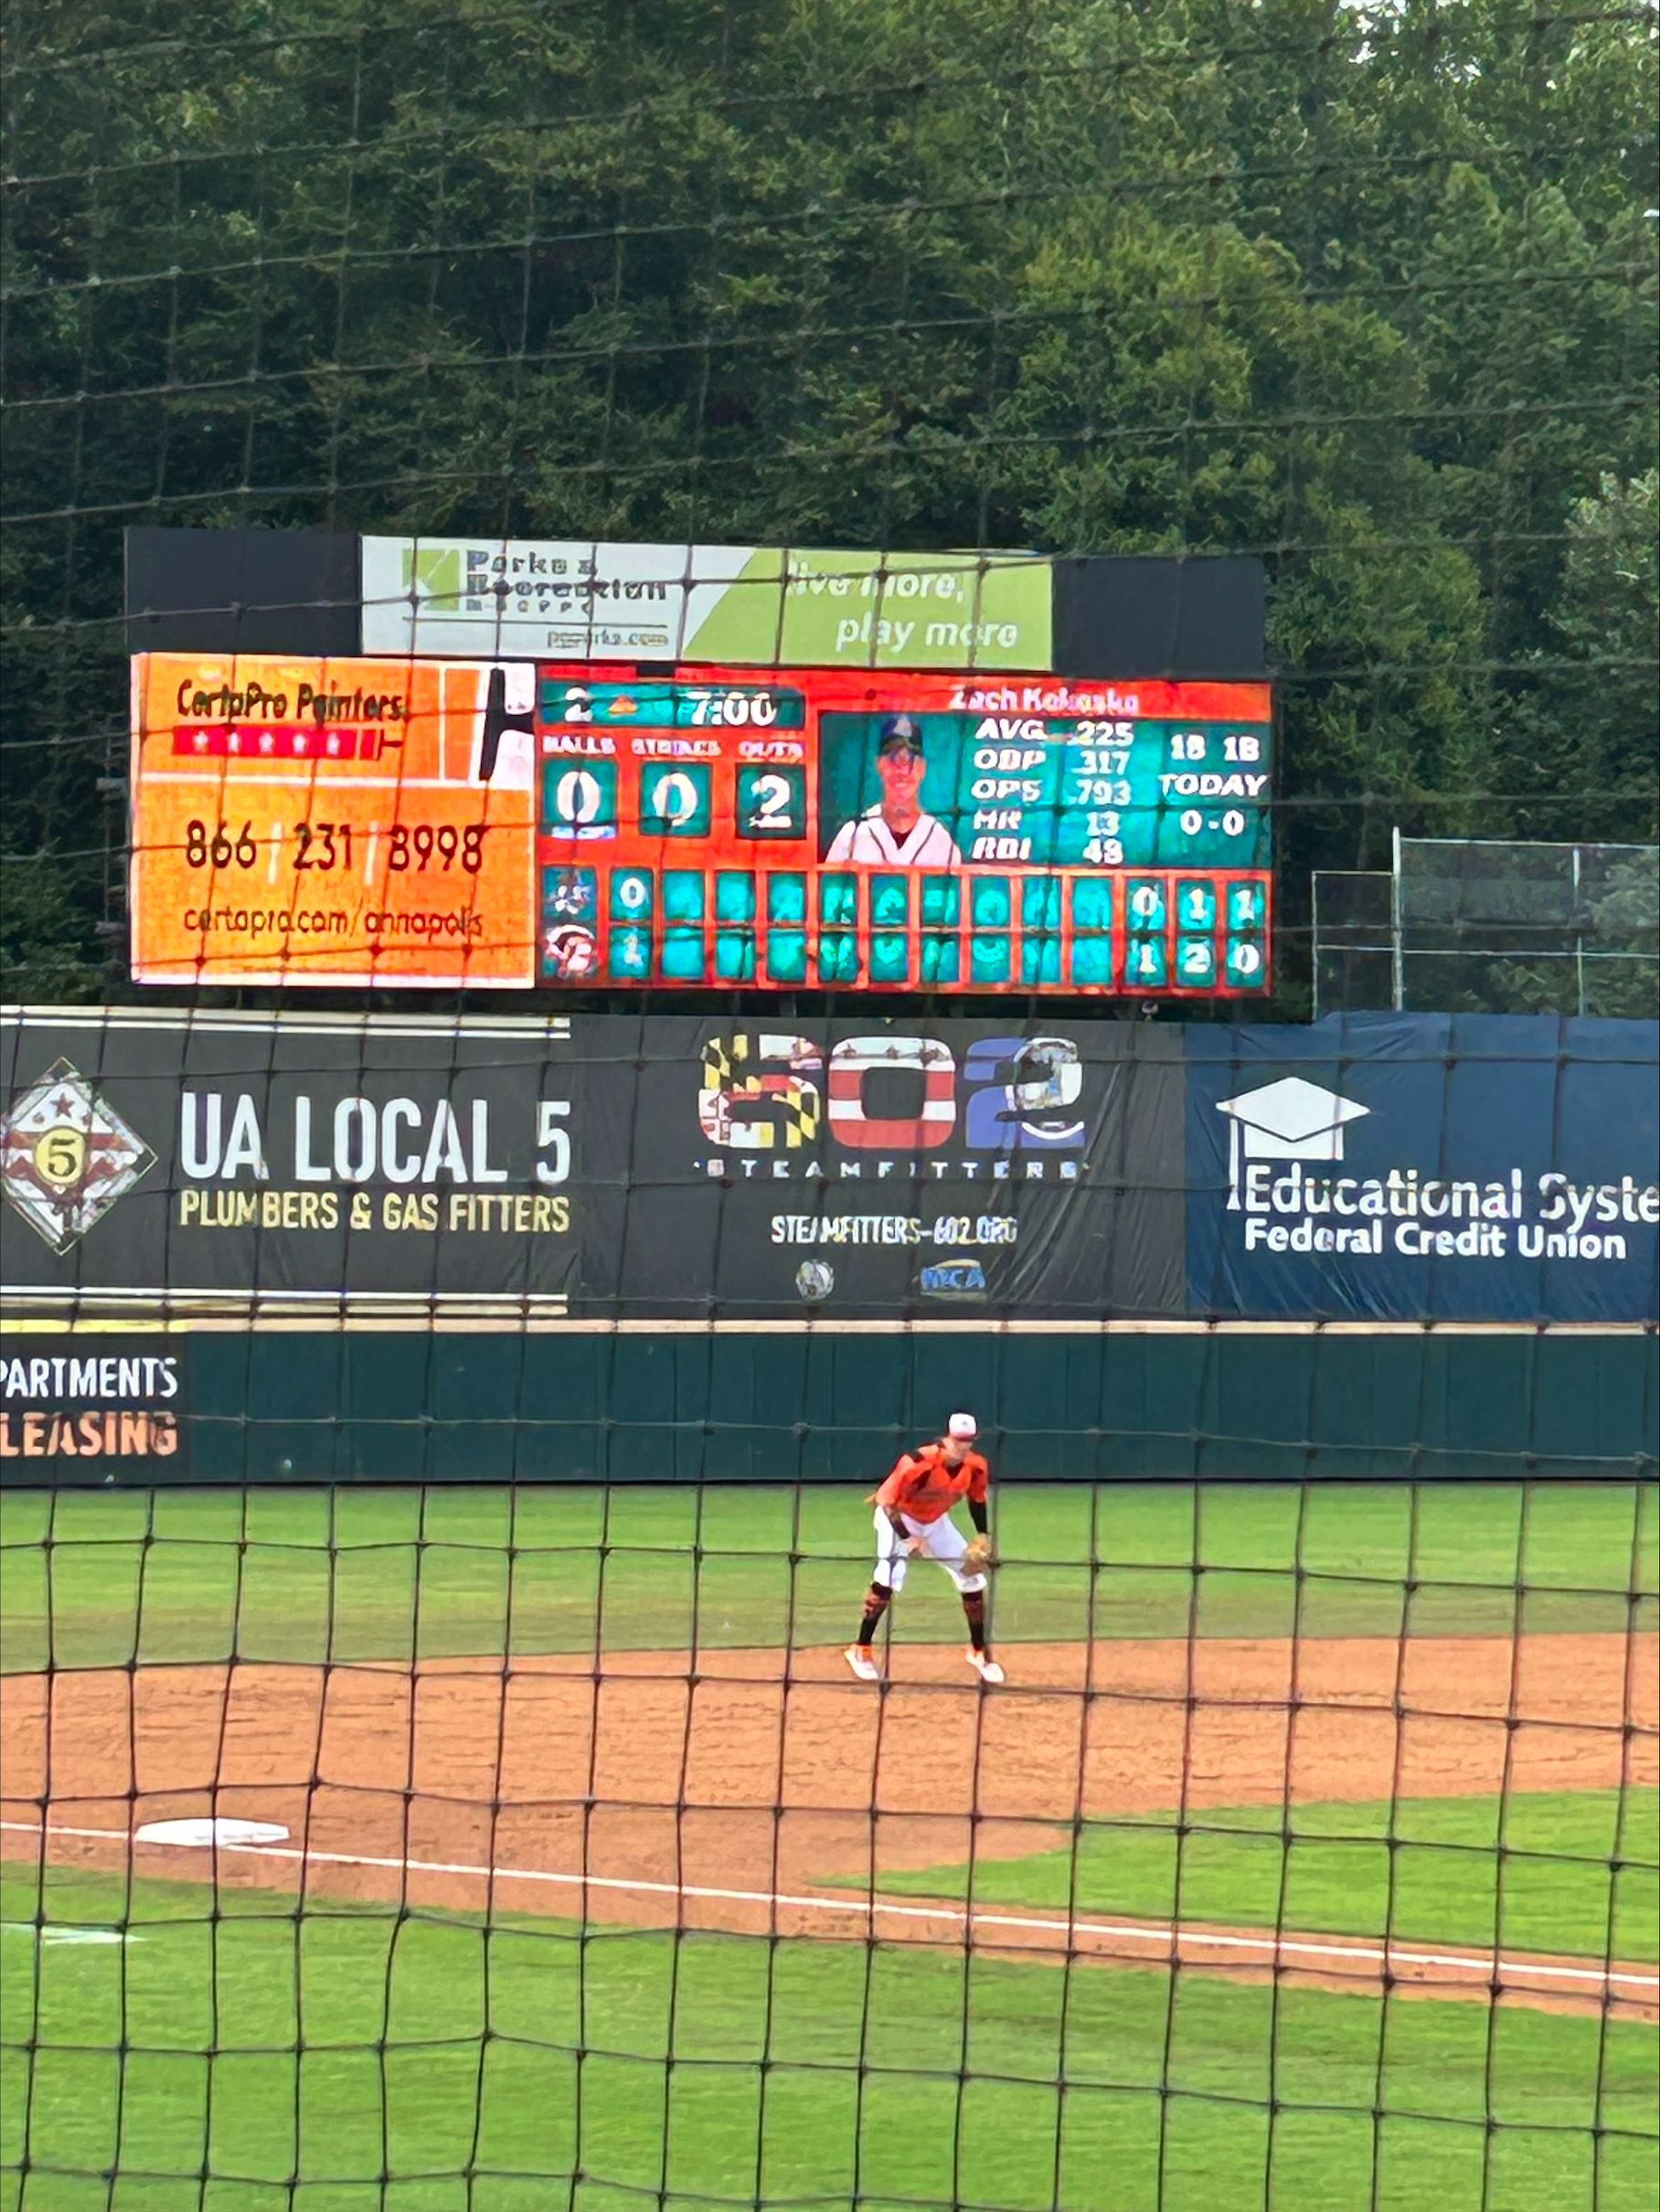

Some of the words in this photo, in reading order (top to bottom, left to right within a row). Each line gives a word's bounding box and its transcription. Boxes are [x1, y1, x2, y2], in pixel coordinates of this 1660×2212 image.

[835, 611, 915, 654] play
[925, 621, 1018, 648] more
[564, 686, 593, 723] 2
[685, 690, 778, 727] 7:00
[543, 735, 617, 755] BALLS
[974, 718, 1048, 741] AVG
[557, 771, 601, 824] 0
[652, 771, 699, 827] 0
[750, 774, 793, 829] 2
[971, 779, 1043, 802] OPS
[1157, 774, 1269, 797] TODAY
[1086, 810, 1121, 837] 13
[1180, 809, 1245, 836] 0-0
[186, 820, 257, 870] 866
[293, 822, 352, 871] 231
[389, 824, 484, 874] 8998
[619, 877, 646, 909] 0
[1132, 885, 1158, 917] 0
[1184, 942, 1212, 974] 2
[1233, 943, 1261, 975] 0
[48, 1138, 78, 1177] 5
[181, 1092, 270, 1179] UA
[294, 1095, 508, 1184] LOCAL
[536, 1101, 571, 1186] 5
[180, 1189, 339, 1230] PLUMBERS
[349, 1192, 372, 1231] &
[382, 1192, 439, 1232] GAS
[449, 1194, 569, 1234] FITTERS
[1245, 1163, 1522, 1218] Educational
[1539, 1172, 1660, 1234] Syste
[1245, 1218, 1383, 1255] Federal
[1394, 1221, 1506, 1258] Credit
[1517, 1225, 1627, 1260] Union
[0, 1409, 178, 1457] LEASING
